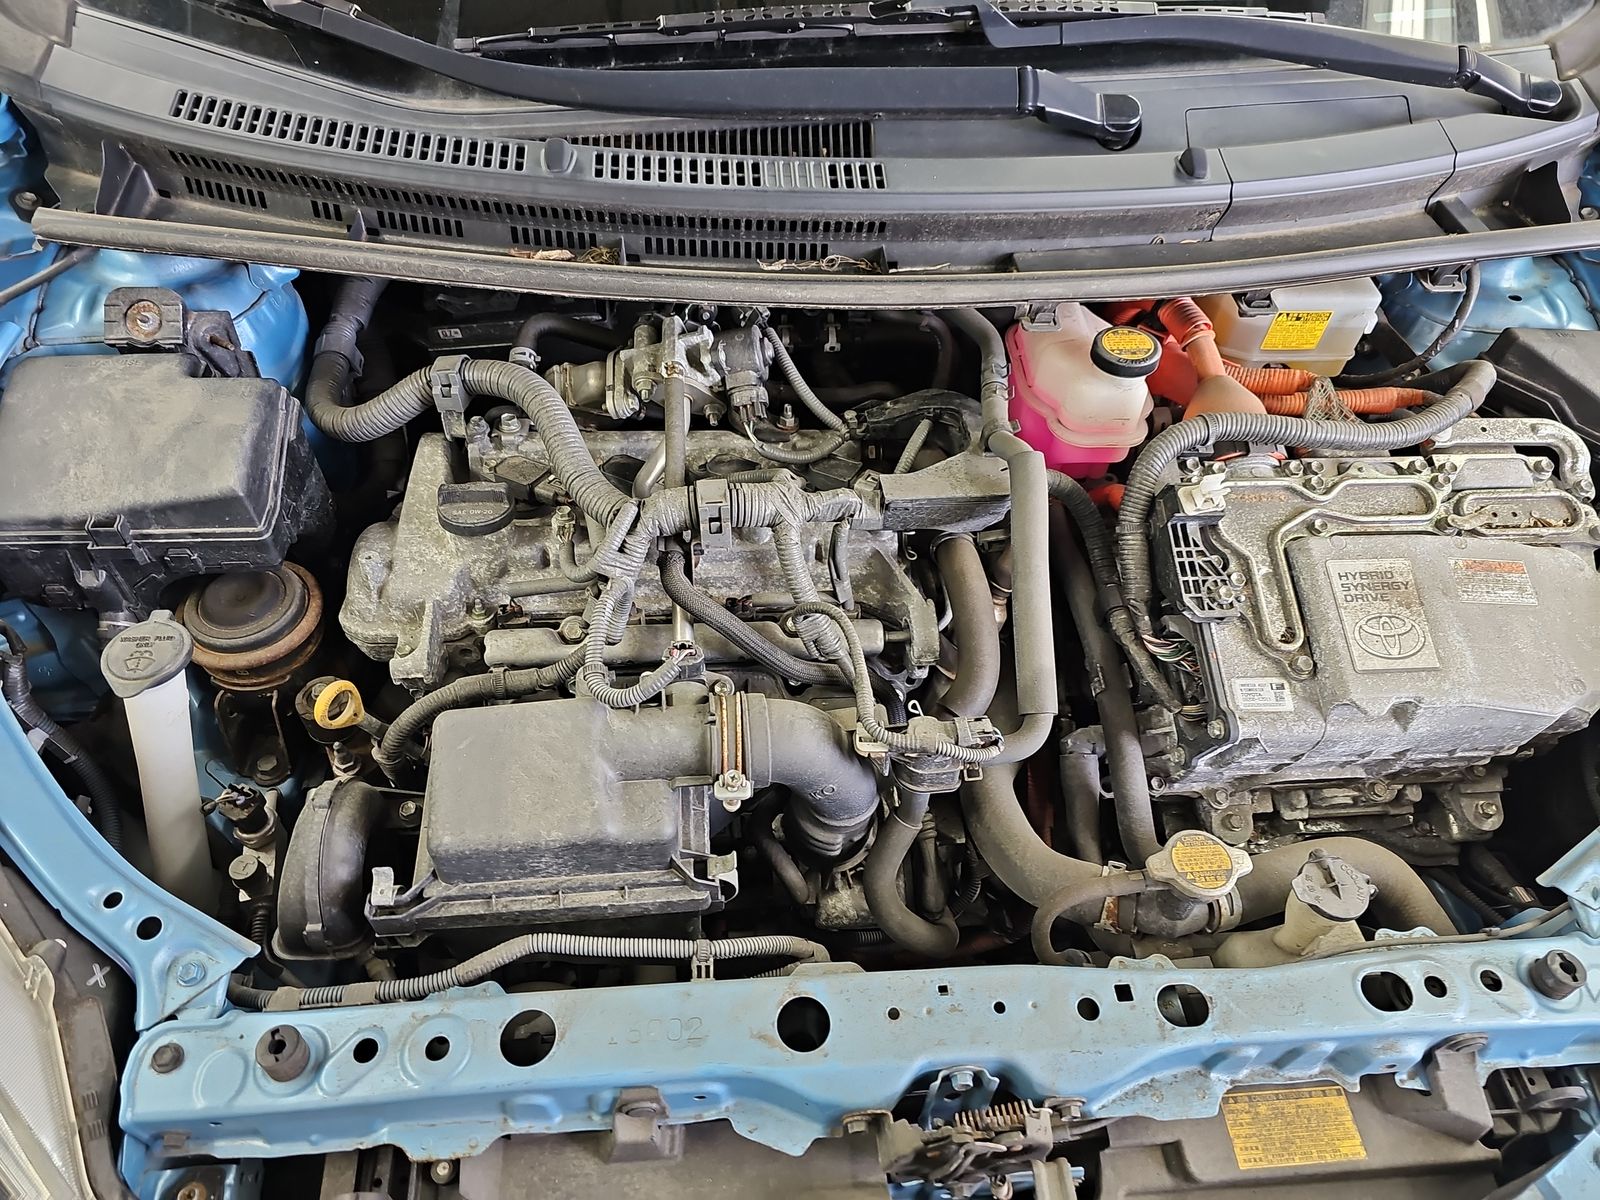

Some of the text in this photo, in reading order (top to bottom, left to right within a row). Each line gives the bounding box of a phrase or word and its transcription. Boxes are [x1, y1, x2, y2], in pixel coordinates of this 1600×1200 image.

[1337, 570, 1394, 581] HYBRID
[1340, 580, 1410, 592] SYNERGY
[1344, 592, 1390, 603] DRIVE
[1340, 863, 1366, 904] COOLANT
